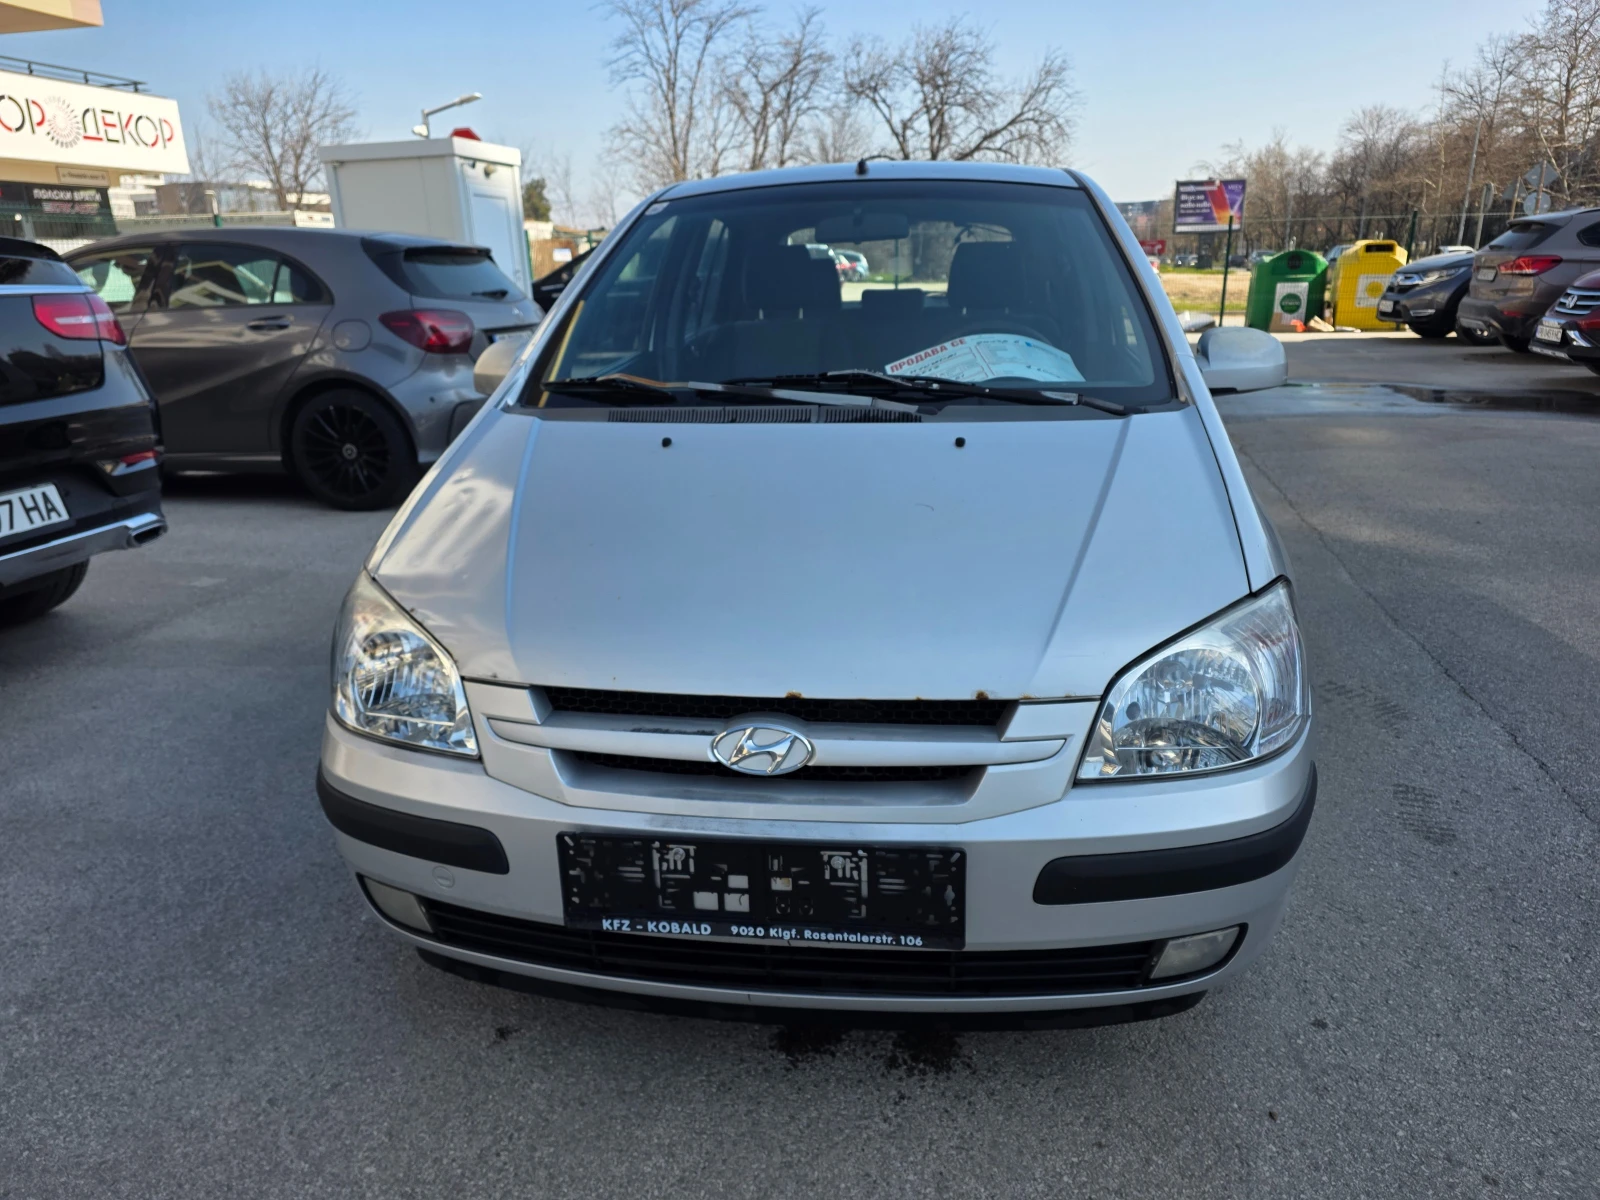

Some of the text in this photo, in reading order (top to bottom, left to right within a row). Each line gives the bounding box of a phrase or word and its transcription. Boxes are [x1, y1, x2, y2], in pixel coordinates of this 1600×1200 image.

[82, 107, 174, 149] ДЕКОР
[890, 344, 948, 373] ПРОДАВА
[950, 338, 967, 348] СЕ
[19, 491, 62, 525] HA
[602, 918, 631, 932] KFZ
[647, 921, 712, 935] KOBALD
[731, 925, 765, 937] 9020
[769, 927, 800, 940] Klgf.
[900, 935, 923, 947] 106
